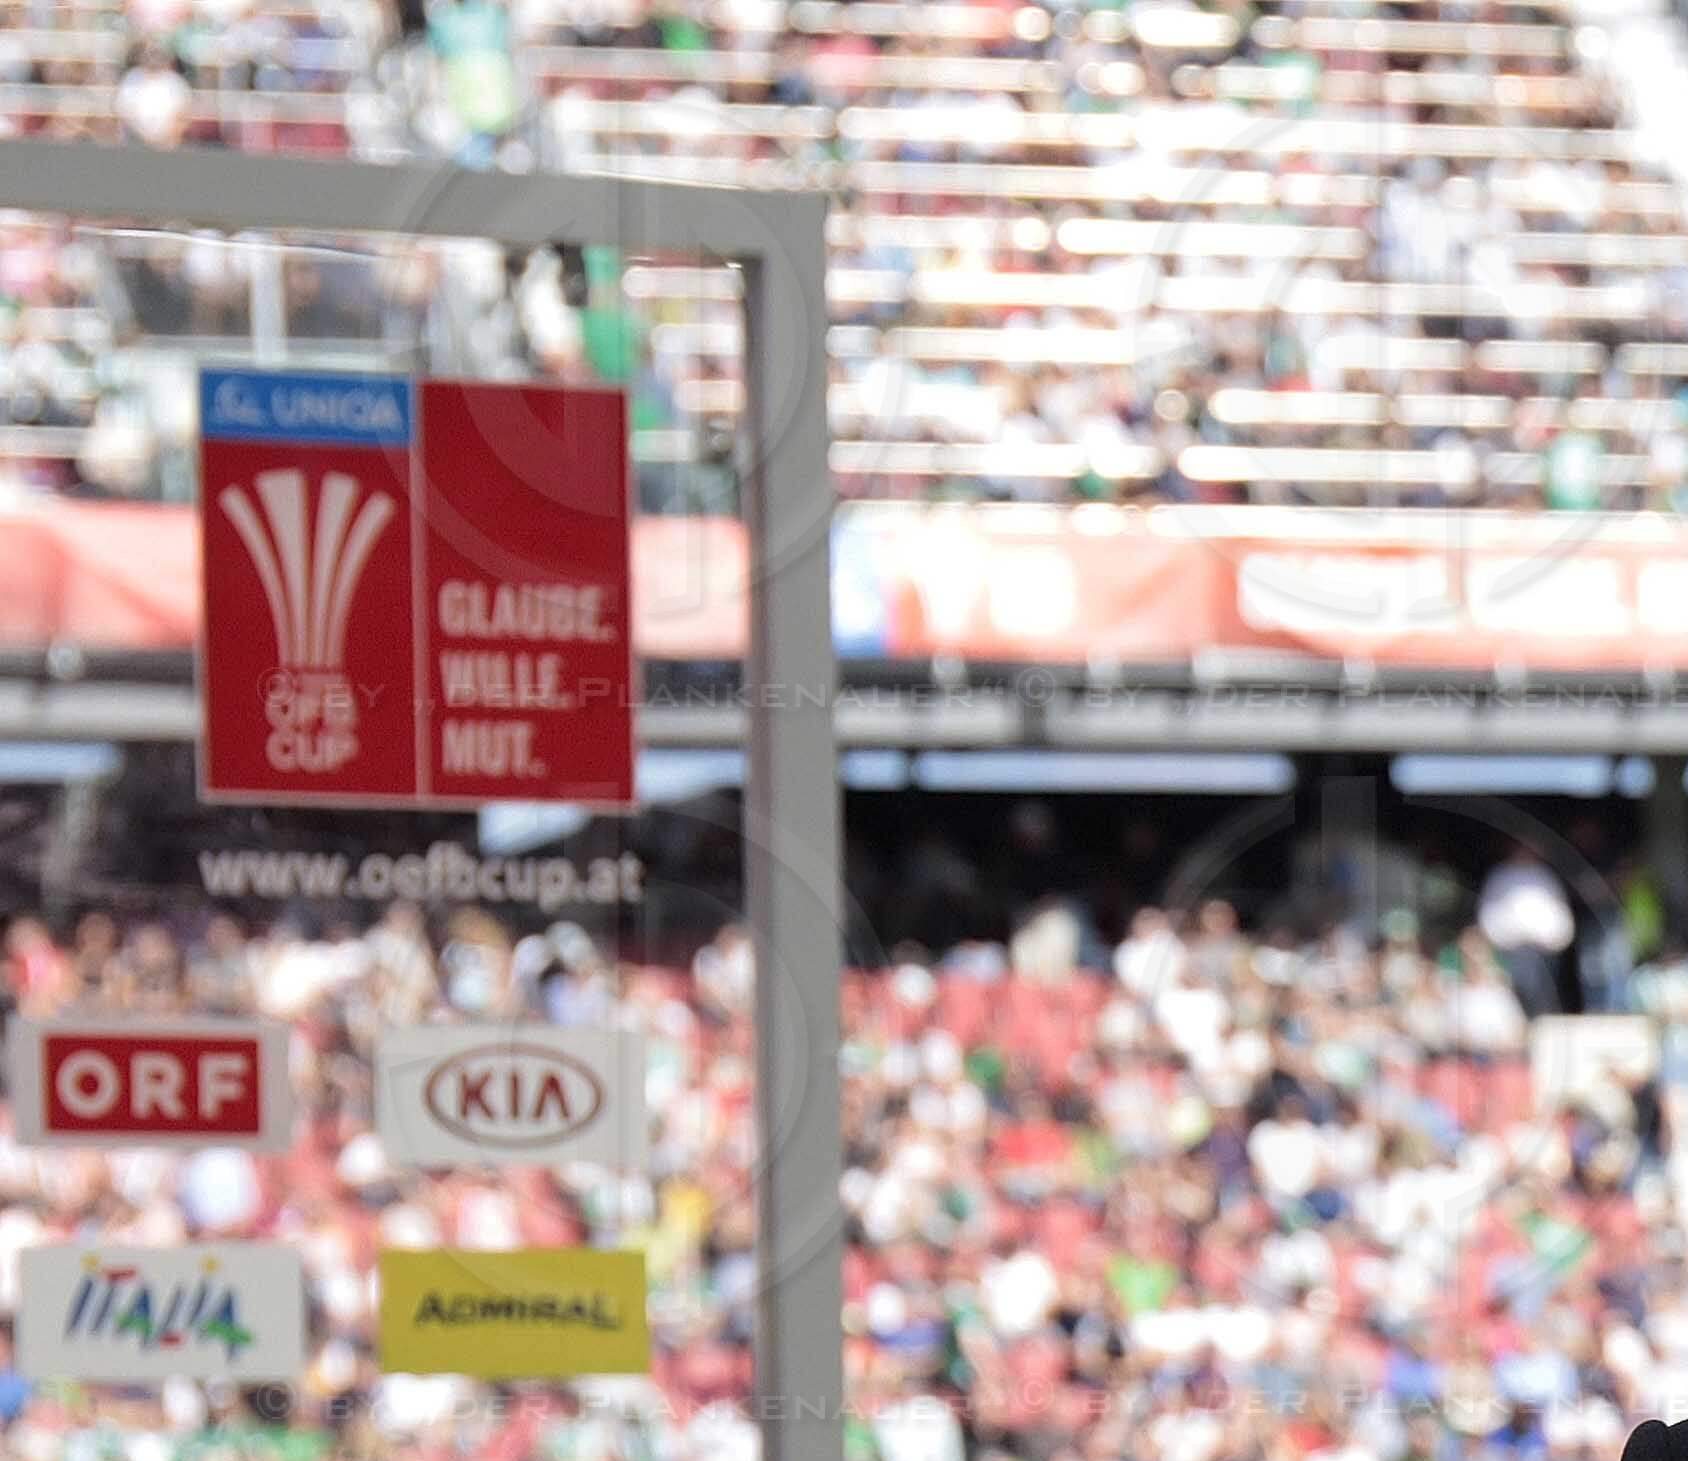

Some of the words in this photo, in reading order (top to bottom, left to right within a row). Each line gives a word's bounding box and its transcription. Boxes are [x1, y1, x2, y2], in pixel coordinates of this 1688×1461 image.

[442, 718, 547, 778] MUT.
[55, 1049, 247, 1120] ORF
[457, 1066, 574, 1121] KIA
